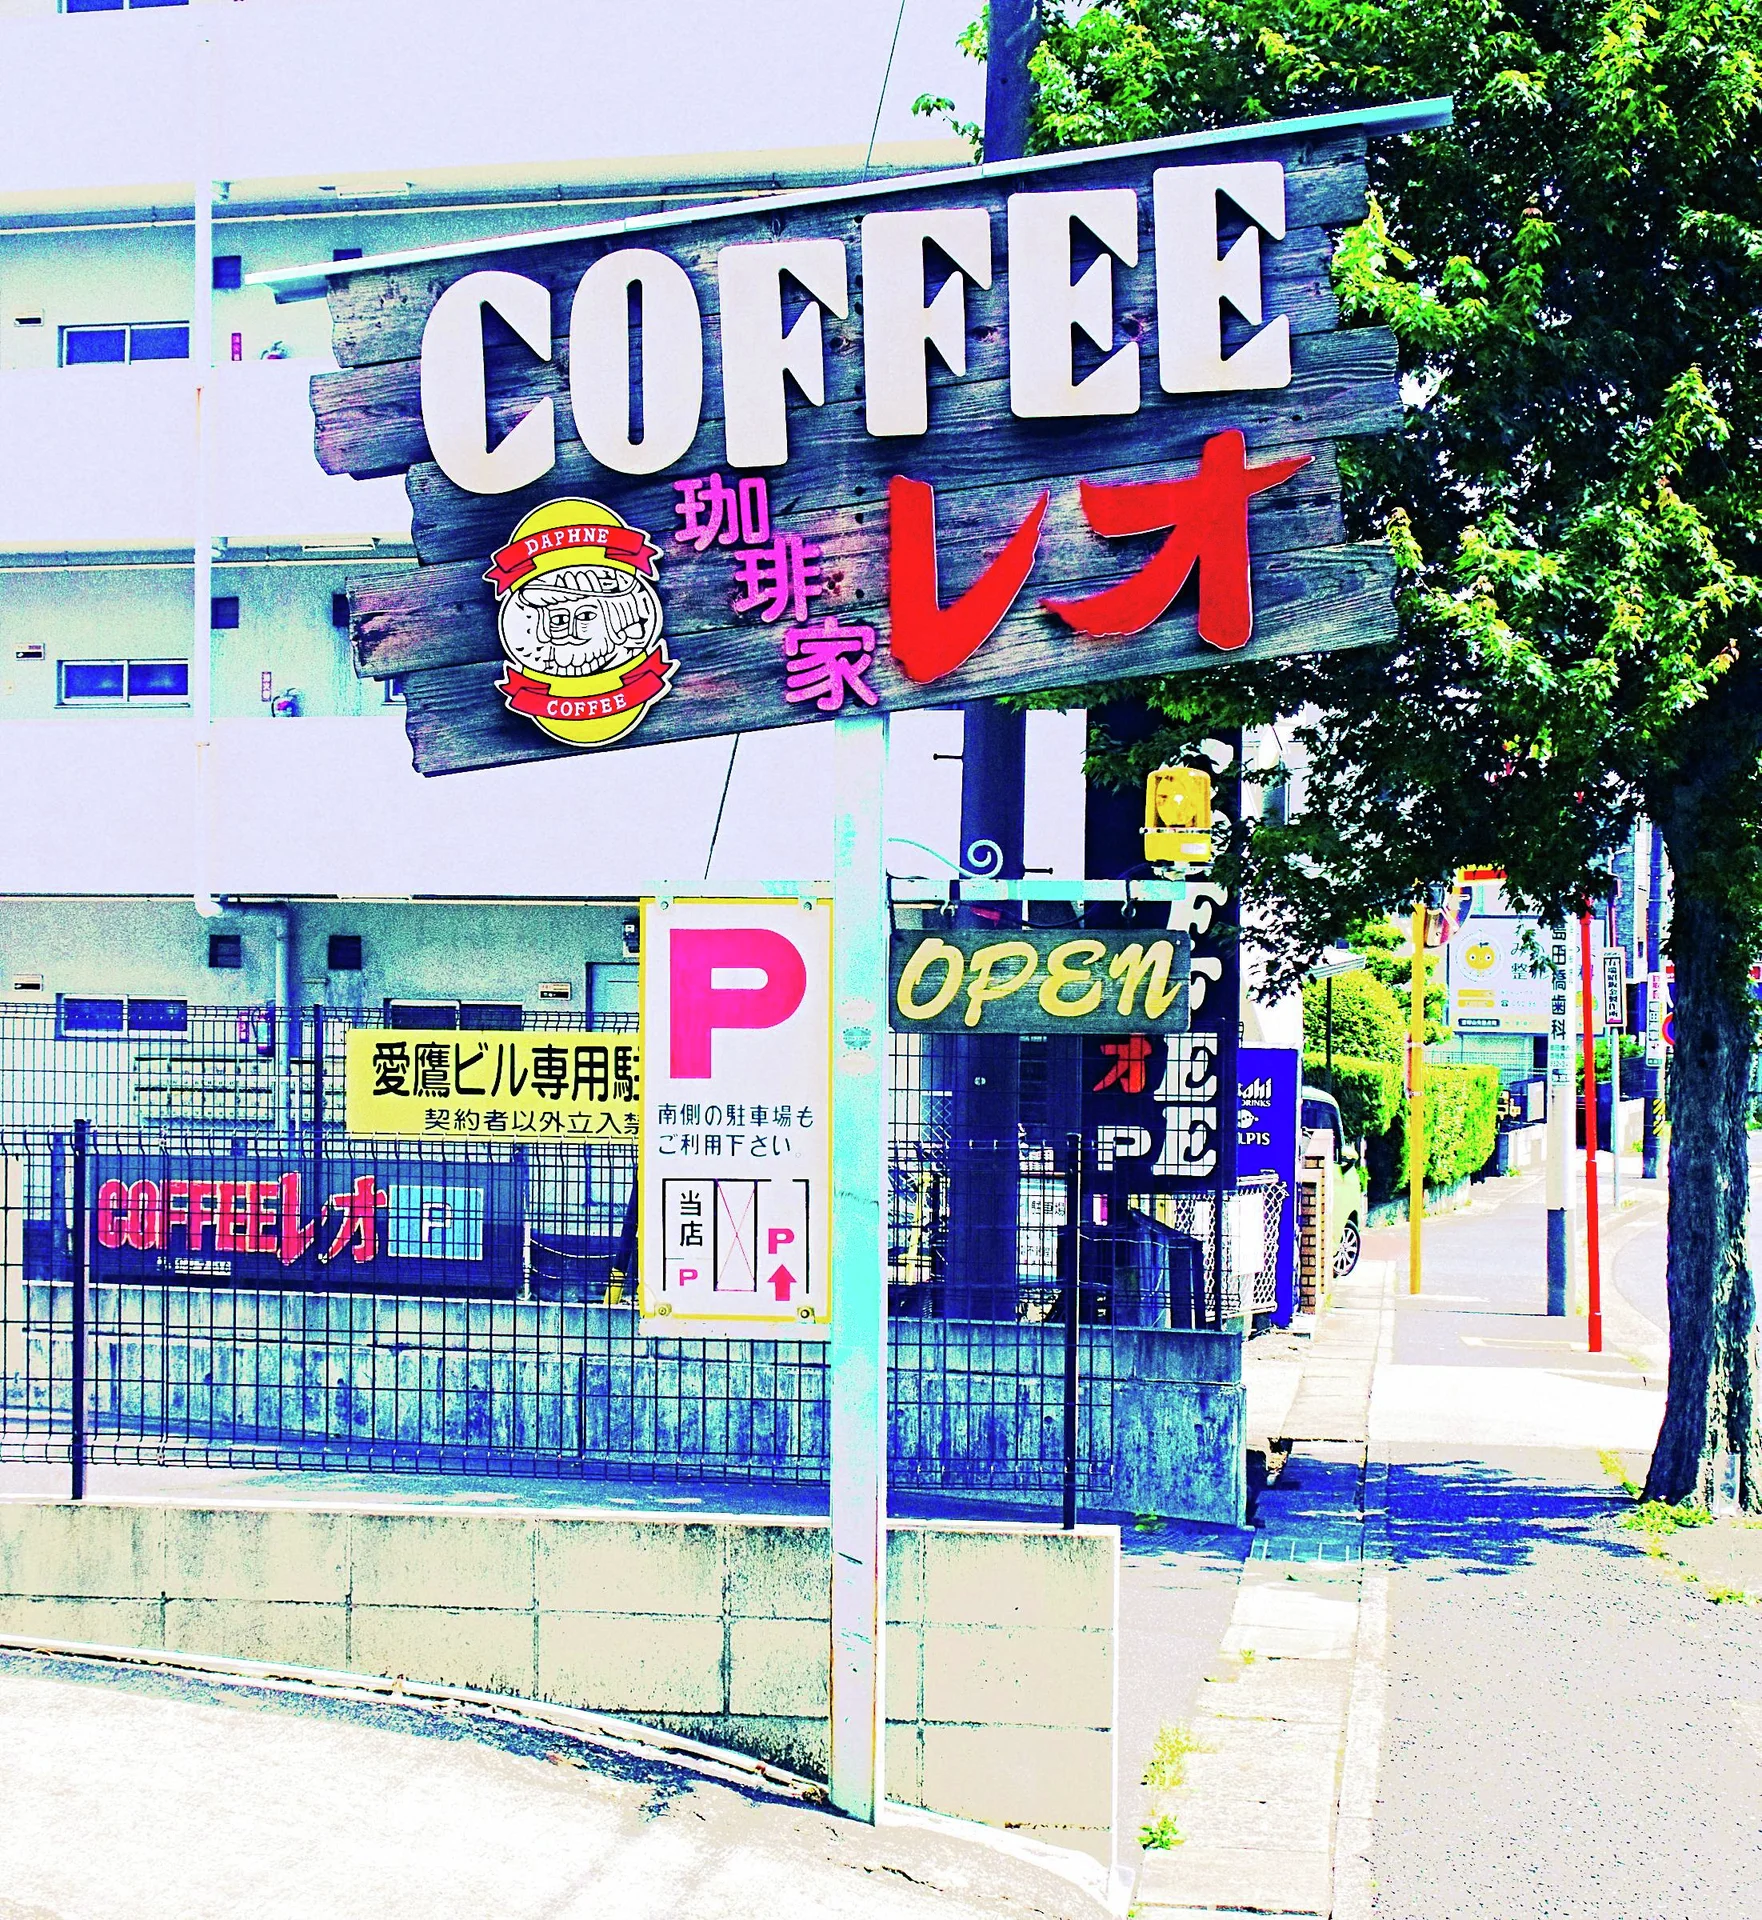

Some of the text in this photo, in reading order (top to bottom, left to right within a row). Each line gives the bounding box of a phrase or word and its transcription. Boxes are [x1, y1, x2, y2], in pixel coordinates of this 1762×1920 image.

[420, 160, 1293, 496] COFFEE
[523, 527, 611, 557] DAPHNE
[888, 428, 1316, 685] レオ
[672, 472, 881, 713] 珈琲家
[546, 692, 628, 718] COFFEE
[669, 928, 808, 1080] P
[896, 937, 1184, 1028] OPEN
[657, 1102, 814, 1129] 南側の駐車場も
[657, 1133, 791, 1158] ご利用下さい
[1097, 1125, 1152, 1171] P
[1237, 1131, 1270, 1146] LPIS
[421, 1200, 453, 1243] P
[679, 1189, 704, 1247] 当店
[767, 1227, 796, 1255] P
[678, 1268, 699, 1287] P
